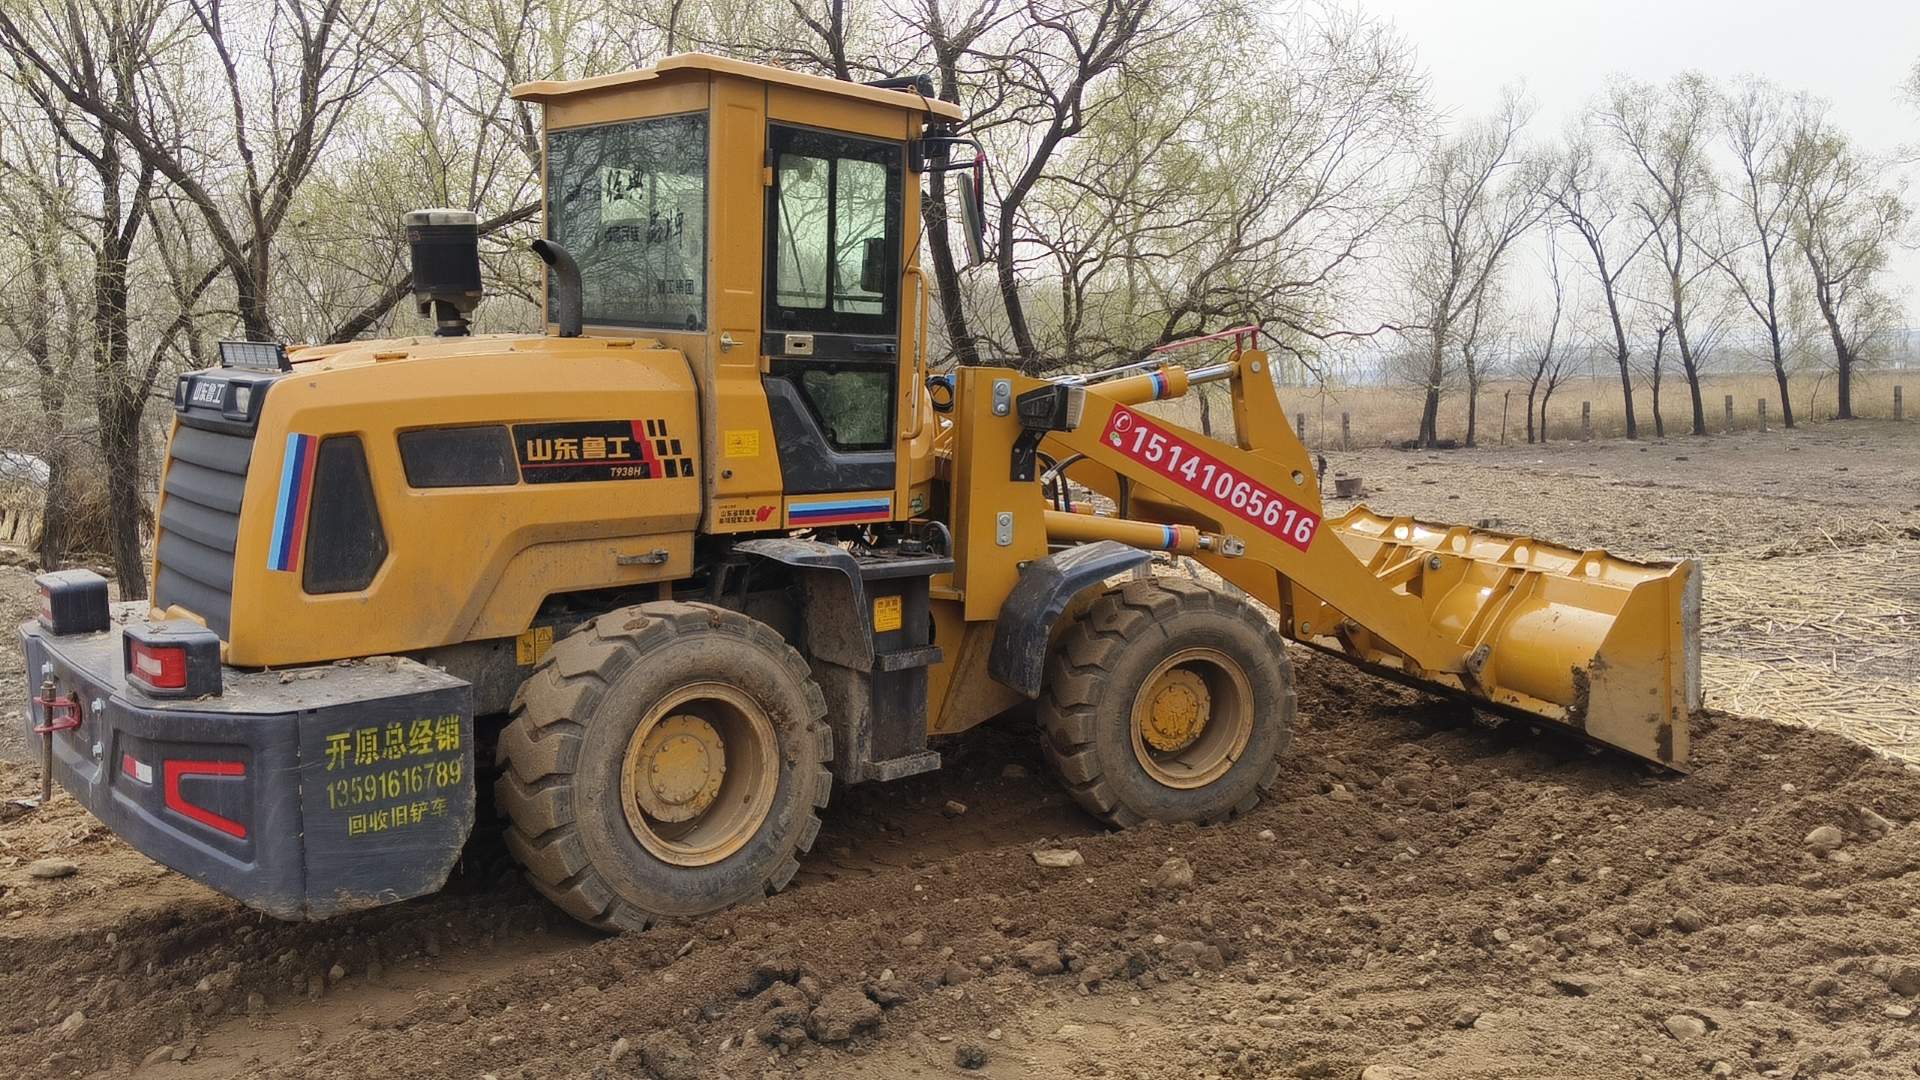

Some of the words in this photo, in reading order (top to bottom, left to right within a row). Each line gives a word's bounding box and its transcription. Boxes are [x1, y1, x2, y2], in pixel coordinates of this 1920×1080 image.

[527, 437, 631, 461] 山东鲁工
[610, 466, 641, 477] T938H
[1131, 426, 1314, 543] 15141065616
[325, 715, 461, 771] 开原总经销
[327, 759, 462, 810] 13591616789
[349, 797, 448, 836] 回收旧铲车
